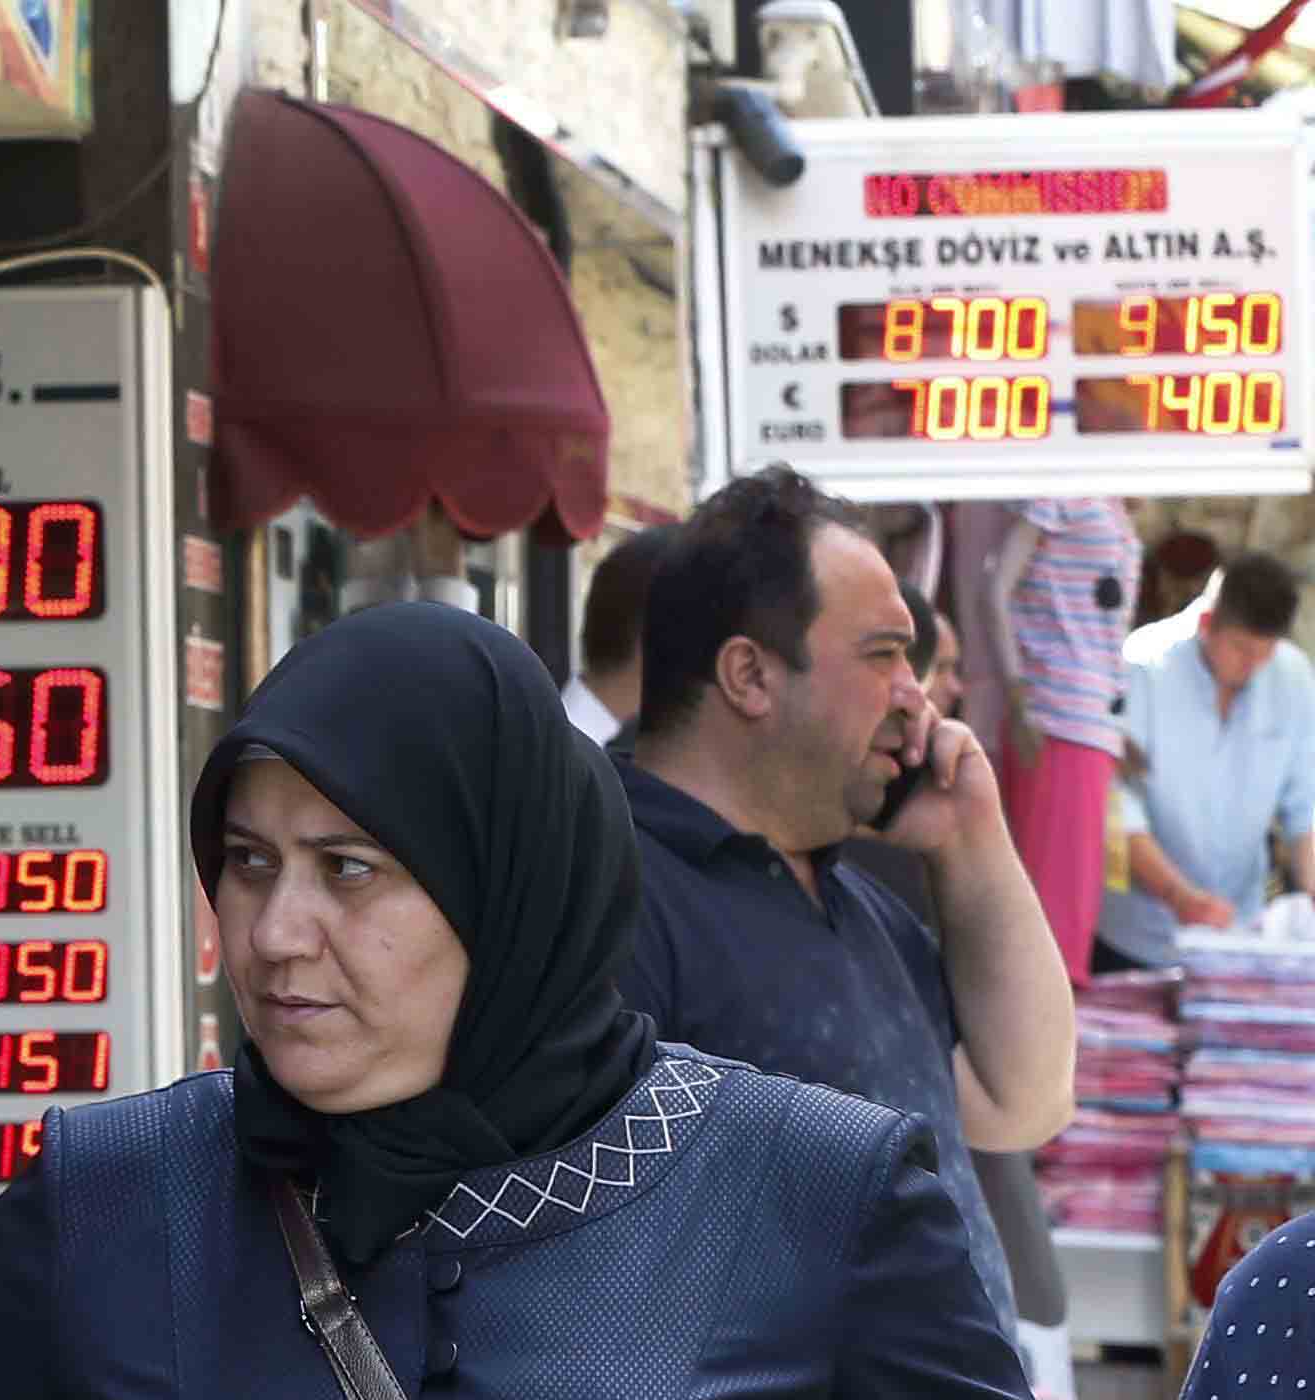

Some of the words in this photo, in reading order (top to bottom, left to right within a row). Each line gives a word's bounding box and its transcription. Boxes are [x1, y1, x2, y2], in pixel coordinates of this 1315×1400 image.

[758, 234, 923, 276] MENEKŞE
[1103, 230, 1199, 262] ALTIN
[1212, 228, 1278, 266] A.Ş.
[891, 376, 1049, 440] 7000
[1126, 371, 1283, 435] 7400
[21, 822, 79, 844] SELL
